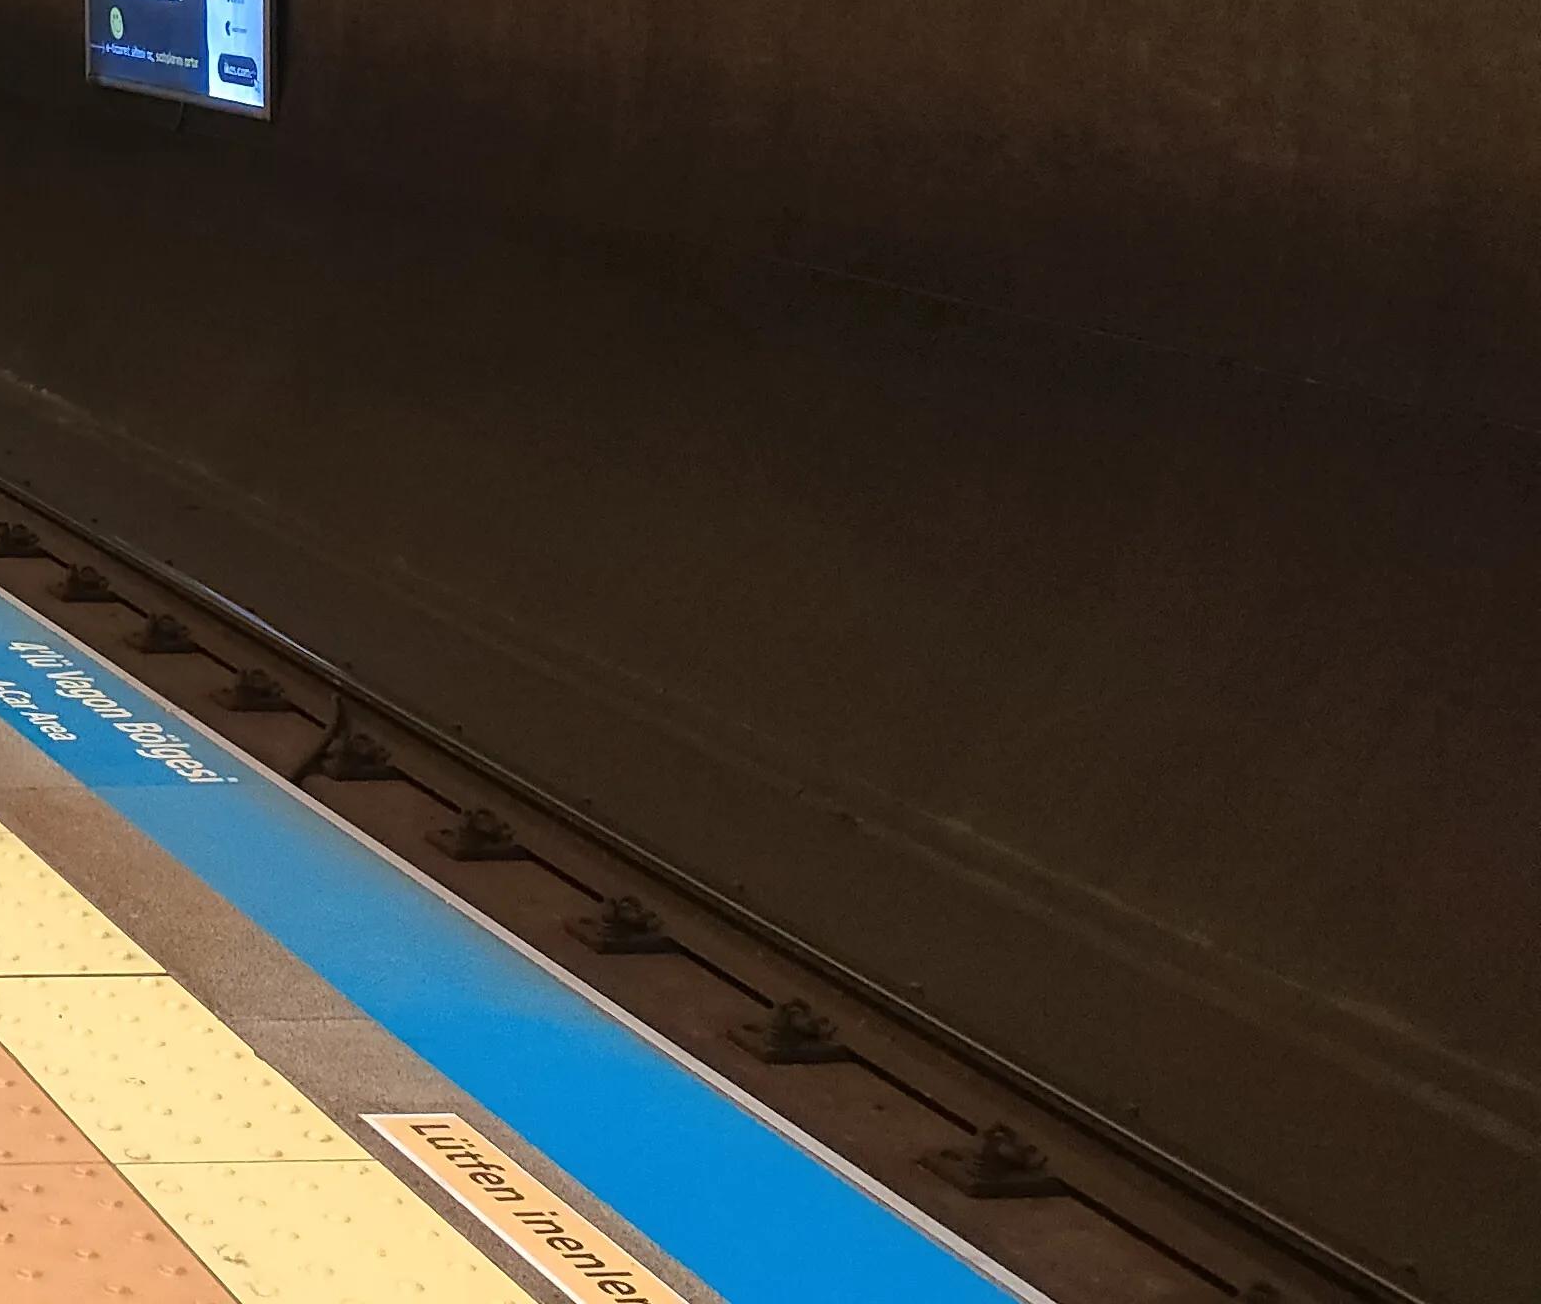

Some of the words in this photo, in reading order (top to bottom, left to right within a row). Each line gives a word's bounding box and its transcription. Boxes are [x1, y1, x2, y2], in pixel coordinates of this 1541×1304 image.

[19, 709, 78, 743] Area
[47, 669, 134, 721] Vagon
[112, 721, 238, 784] Bölgesi
[409, 1122, 525, 1202] Lütfen
